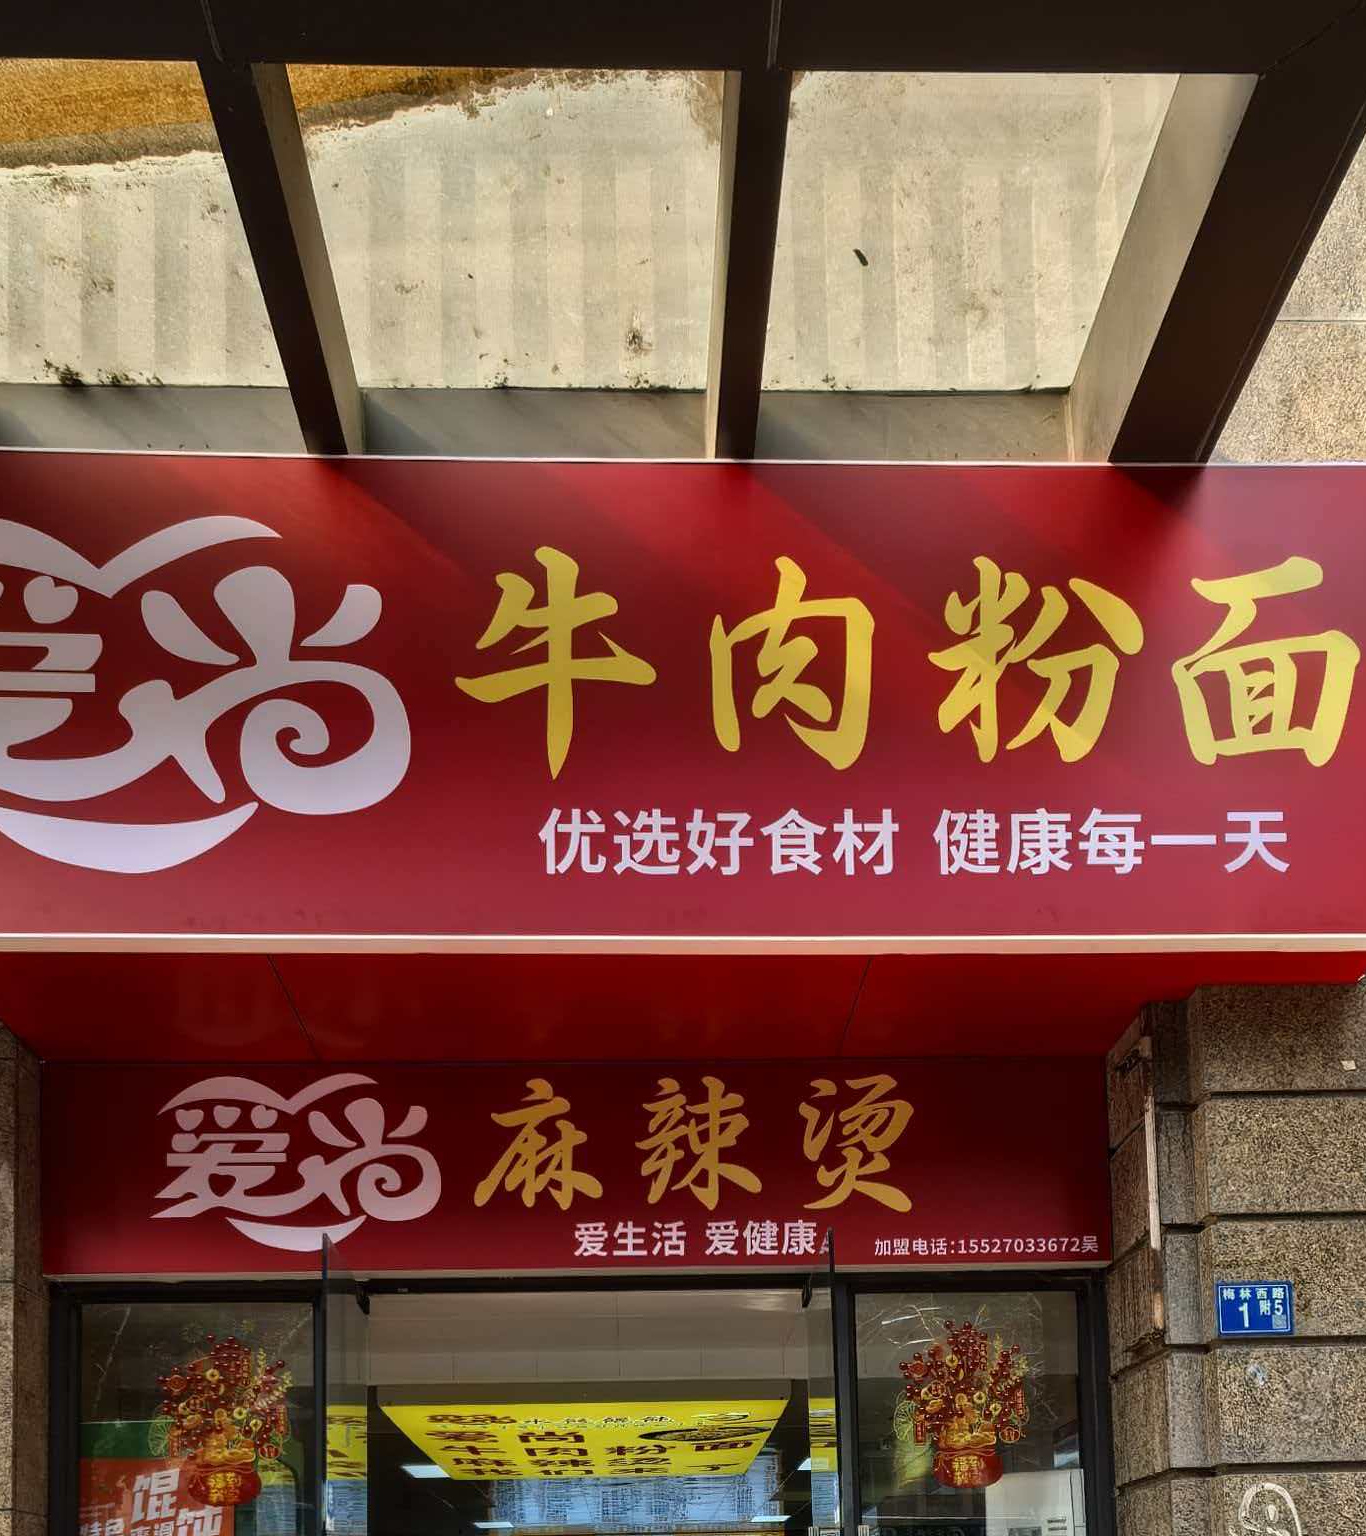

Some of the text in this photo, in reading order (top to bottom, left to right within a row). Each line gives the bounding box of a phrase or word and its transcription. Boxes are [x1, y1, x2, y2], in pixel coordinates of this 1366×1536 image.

[454, 545, 1362, 779] 牛肉粉面
[538, 806, 1290, 877] 优选好食材 健康每一天
[474, 1073, 915, 1213] 麻辣烫
[573, 1219, 818, 1257] 爱生活 爱健康
[1222, 1287, 1285, 1301] 梅林西路
[1238, 1302, 1250, 1328] 1
